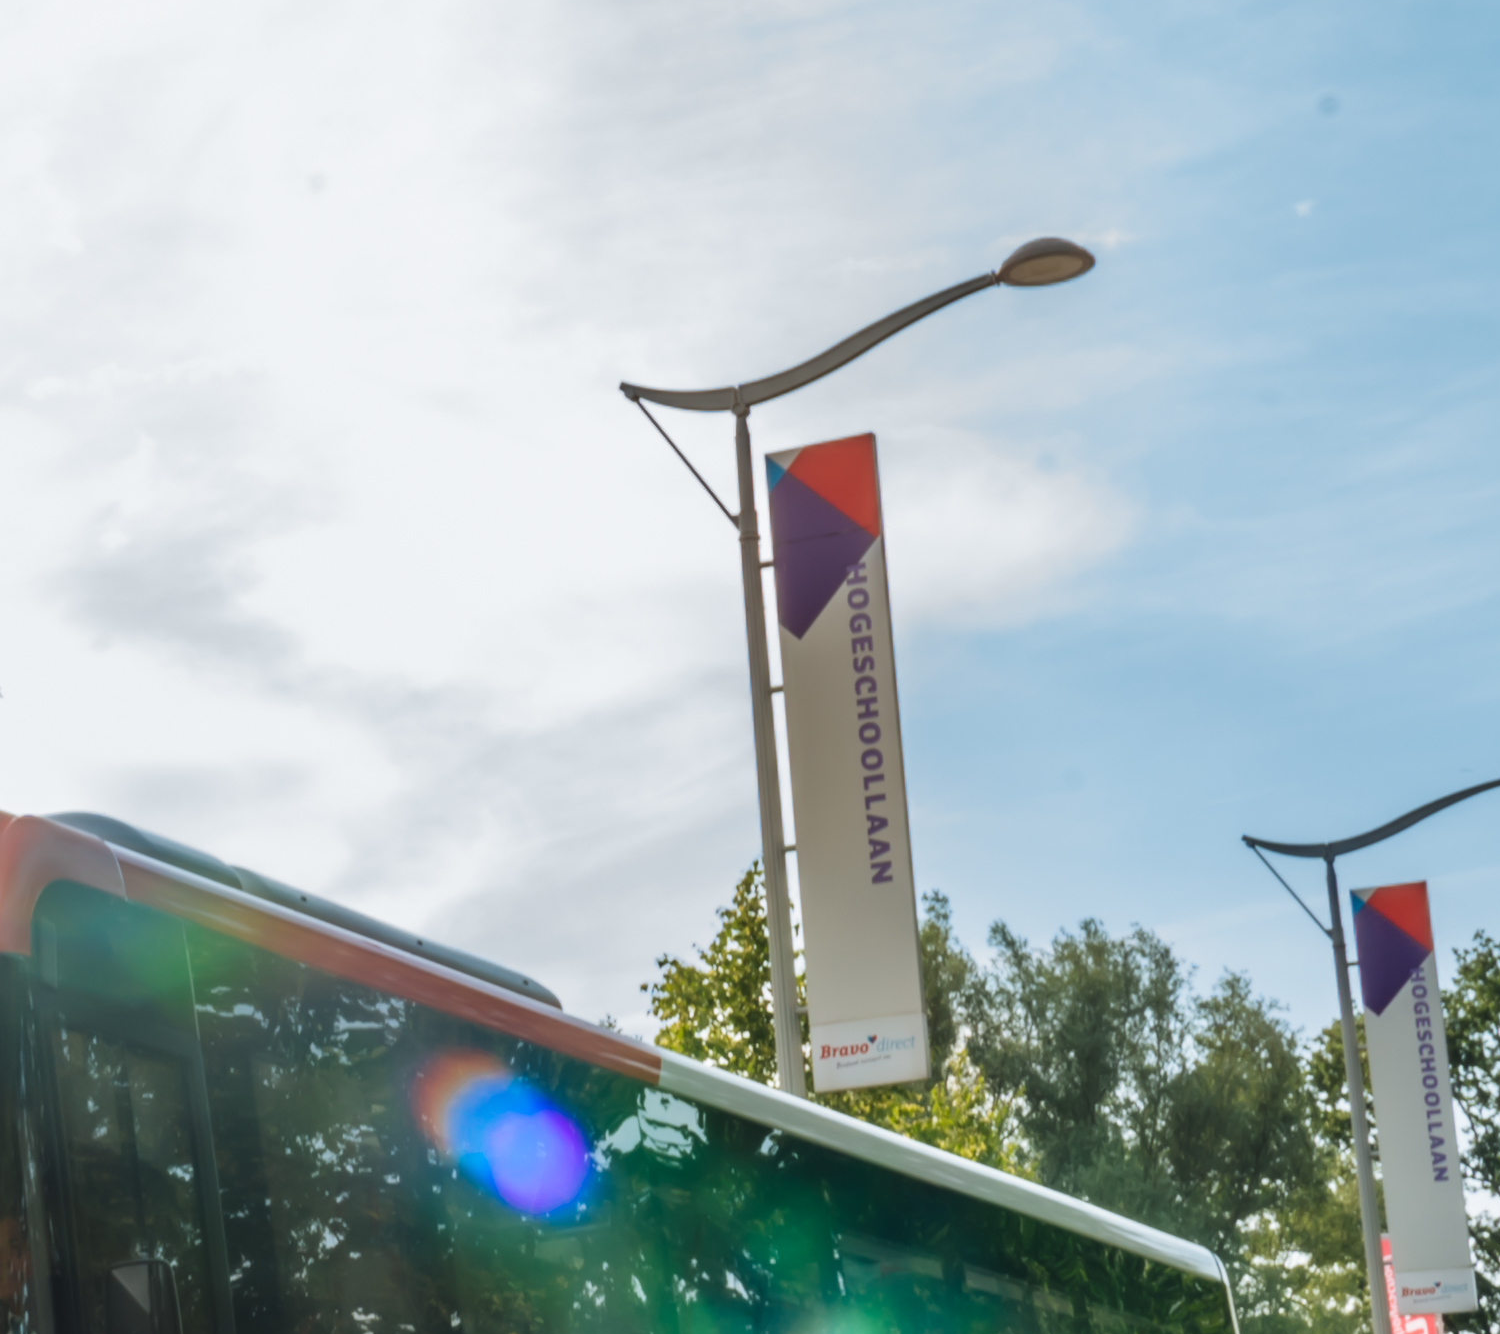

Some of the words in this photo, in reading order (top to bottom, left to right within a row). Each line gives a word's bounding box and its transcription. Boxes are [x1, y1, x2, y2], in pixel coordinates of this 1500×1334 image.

[846, 562, 894, 885] HOGESCHOOLLAAN
[820, 1042, 869, 1060] Bravo
[876, 1035, 915, 1053] direct
[1410, 967, 1449, 1183] HOGESCHOOLLAAN
[1402, 1286, 1436, 1298] Bravo
